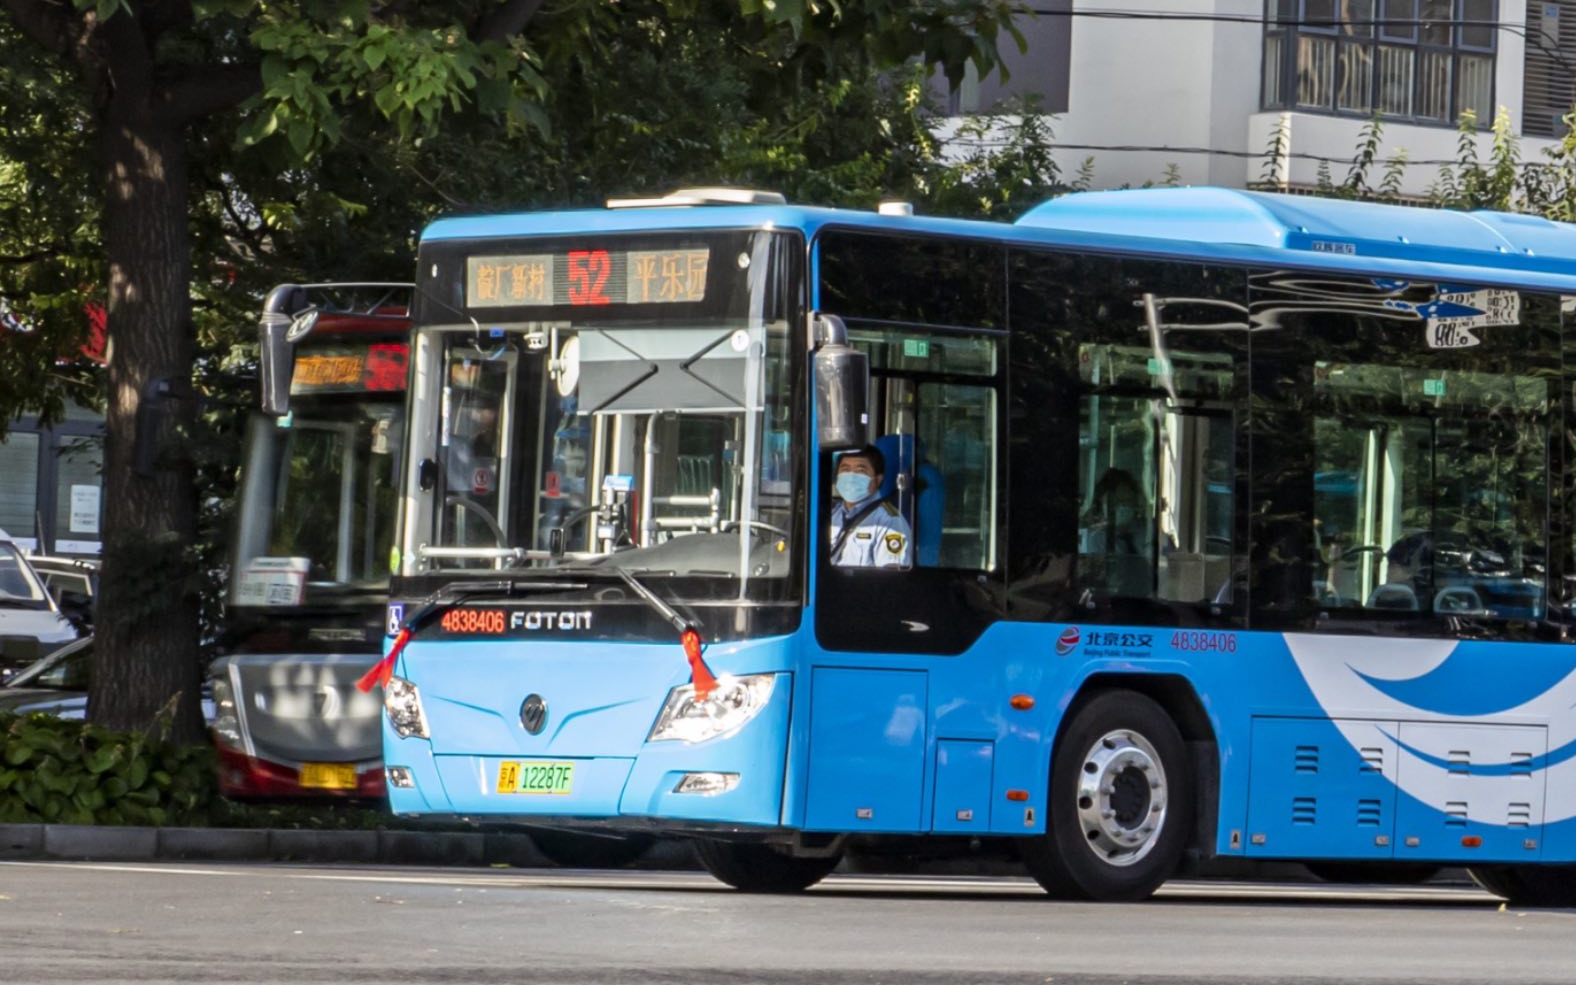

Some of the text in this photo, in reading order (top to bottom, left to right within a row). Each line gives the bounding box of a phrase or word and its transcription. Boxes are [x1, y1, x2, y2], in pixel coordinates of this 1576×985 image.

[567, 249, 611, 306] 52
[634, 252, 709, 303] 平乐园
[441, 609, 505, 633] 4838406
[510, 610, 592, 631] FOTON
[1086, 631, 1153, 648] 北京公交
[1170, 631, 1237, 653] 4838406
